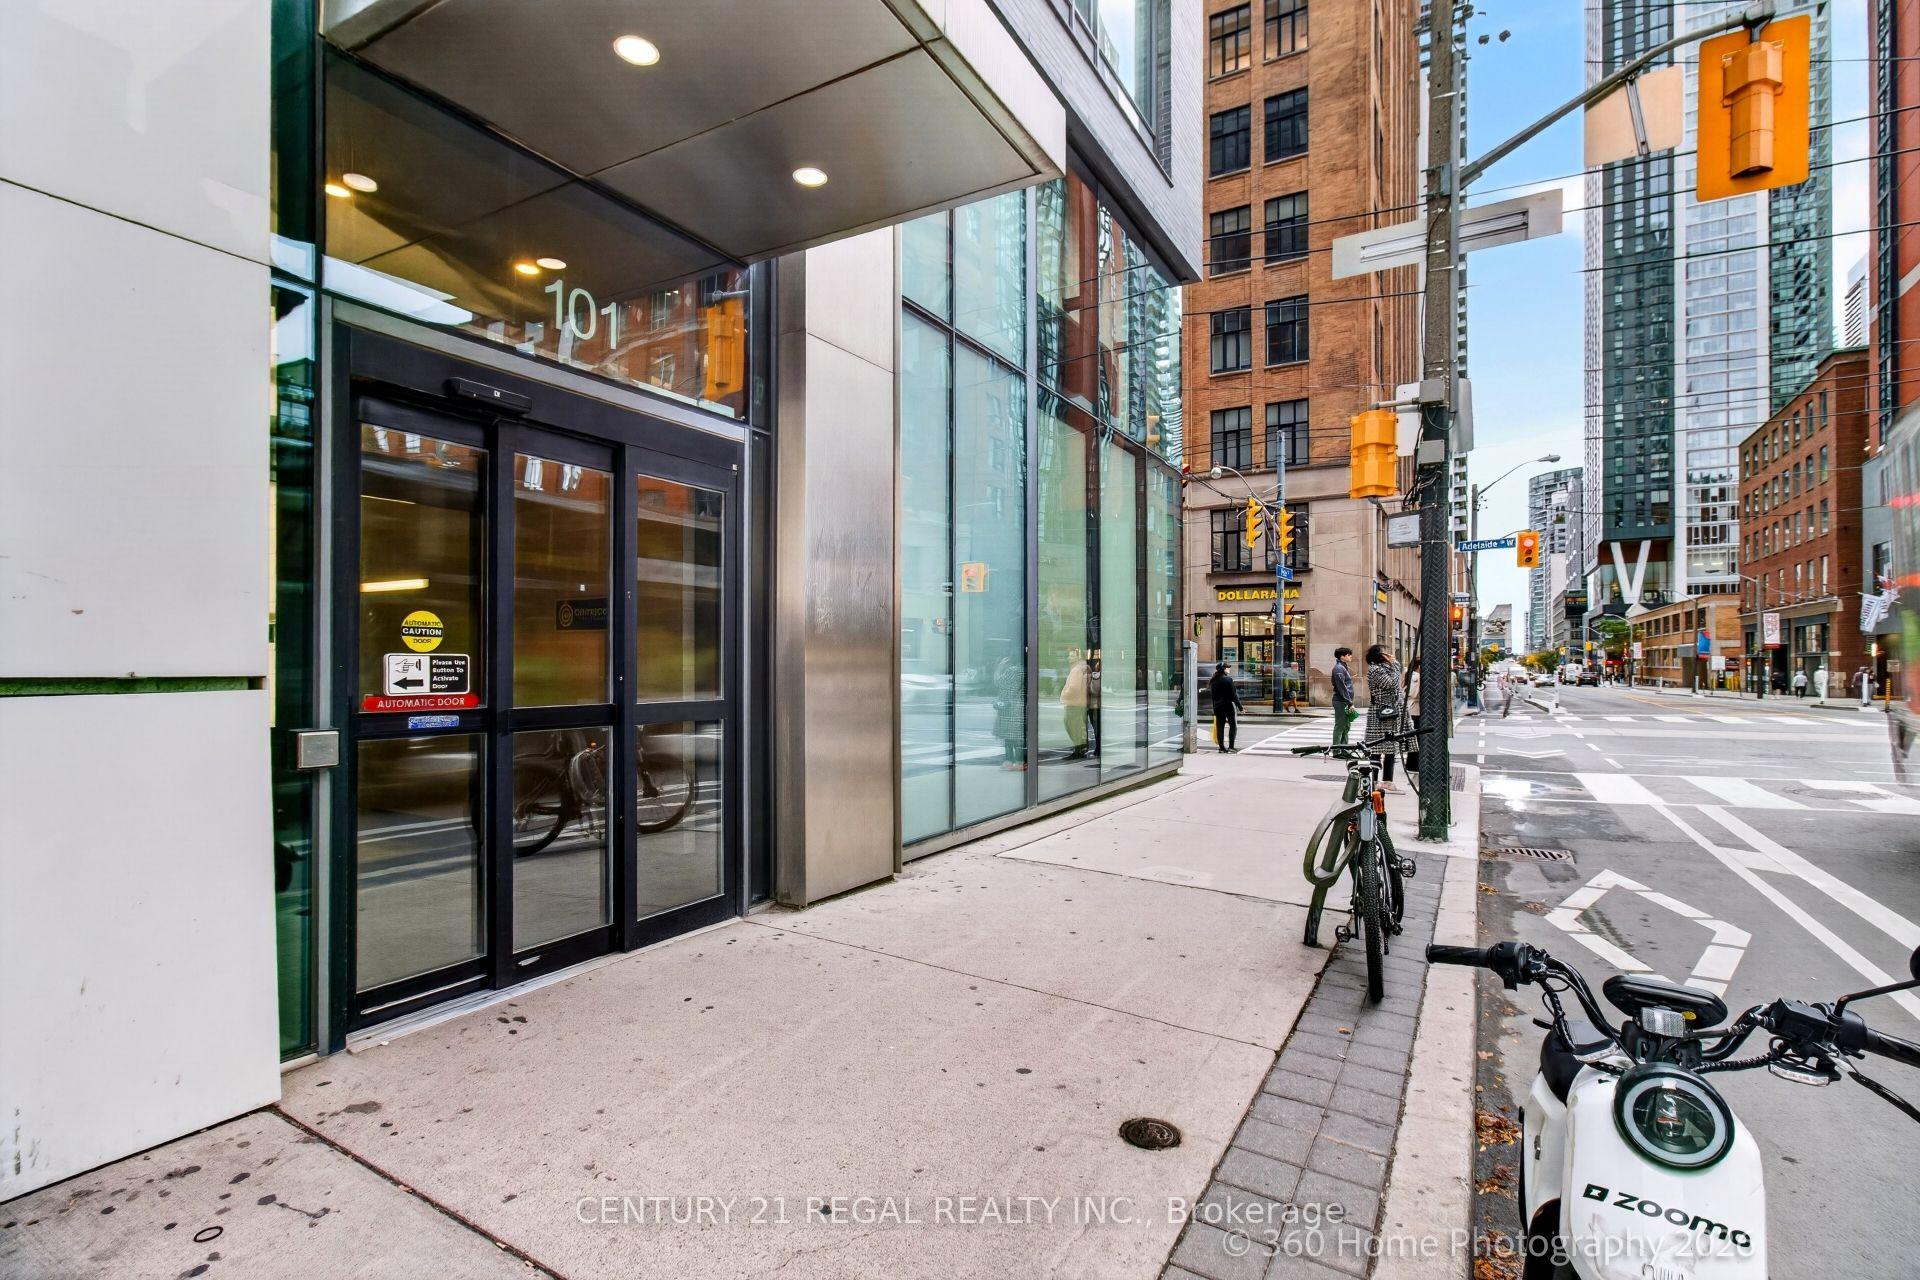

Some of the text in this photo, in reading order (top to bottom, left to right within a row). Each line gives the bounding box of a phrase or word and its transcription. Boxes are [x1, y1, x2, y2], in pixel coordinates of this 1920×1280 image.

[544, 279, 617, 350] 101
[1461, 540, 1498, 551] Adelaide
[1506, 539, 1514, 547] W
[402, 627, 442, 636] CAUTION
[377, 698, 465, 709] AUTOMATIC DOOR
[1613, 1191, 1751, 1248] zoomo
